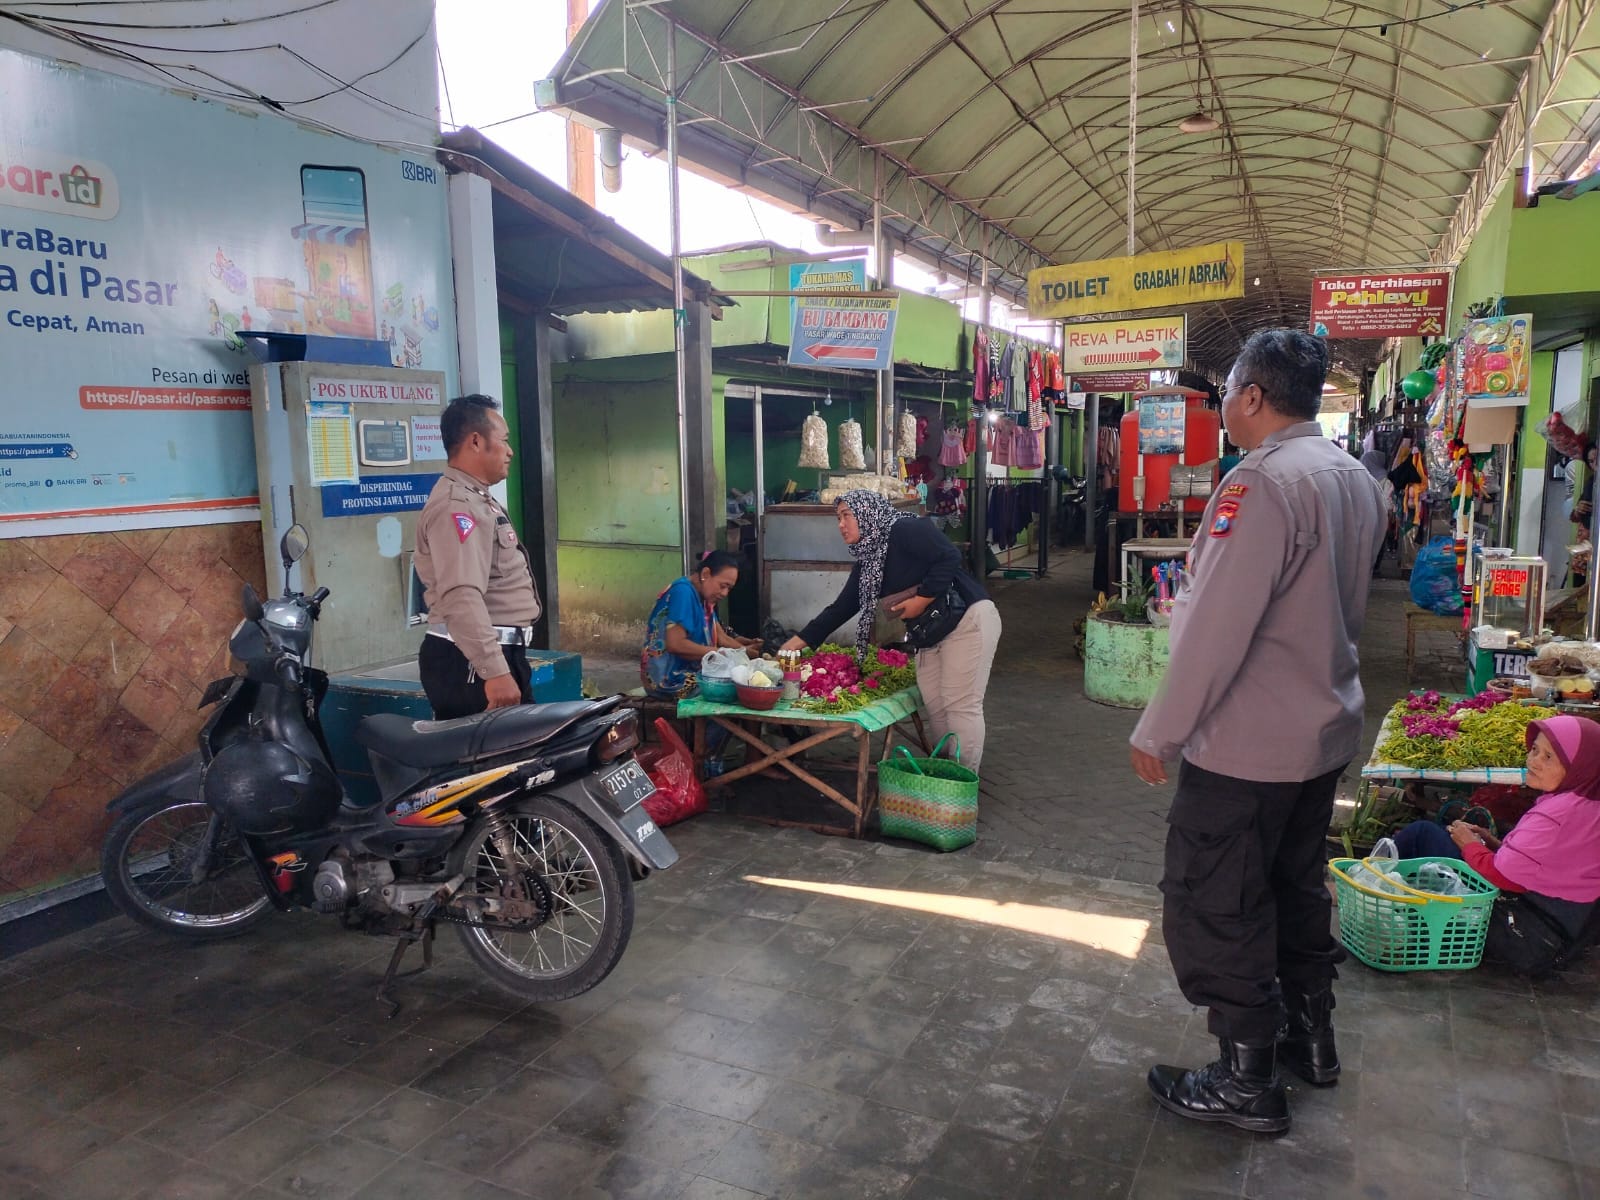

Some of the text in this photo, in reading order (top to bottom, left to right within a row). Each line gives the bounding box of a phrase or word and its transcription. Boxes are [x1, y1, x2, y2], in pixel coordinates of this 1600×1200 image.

[416, 165, 437, 185] BRI
[0, 228, 107, 260] raBaru
[0, 259, 178, 307] a di Pasar
[801, 270, 853, 284] TUKANG MAS
[1041, 276, 1110, 301] TOILET
[1133, 267, 1179, 291] GRABAH
[1188, 262, 1228, 285] ABRAK
[1319, 278, 1443, 291] Toko Perhiasan
[1330, 289, 1430, 307] Pahlevy
[7, 310, 145, 336] Cepat, Aman
[802, 310, 888, 330] BU BAMBANG
[804, 330, 825, 339] PASAR
[826, 331, 845, 340] WAGE
[1069, 327, 1179, 347] REVA PLASTIK
[152, 367, 250, 386] Pesan di web
[318, 383, 433, 400] POS UKUR ULANG
[360, 481, 413, 494] DISPERINDAG
[342, 494, 429, 509] PROVINSI JAWA TIMUR
[1494, 653, 1538, 676] TER
